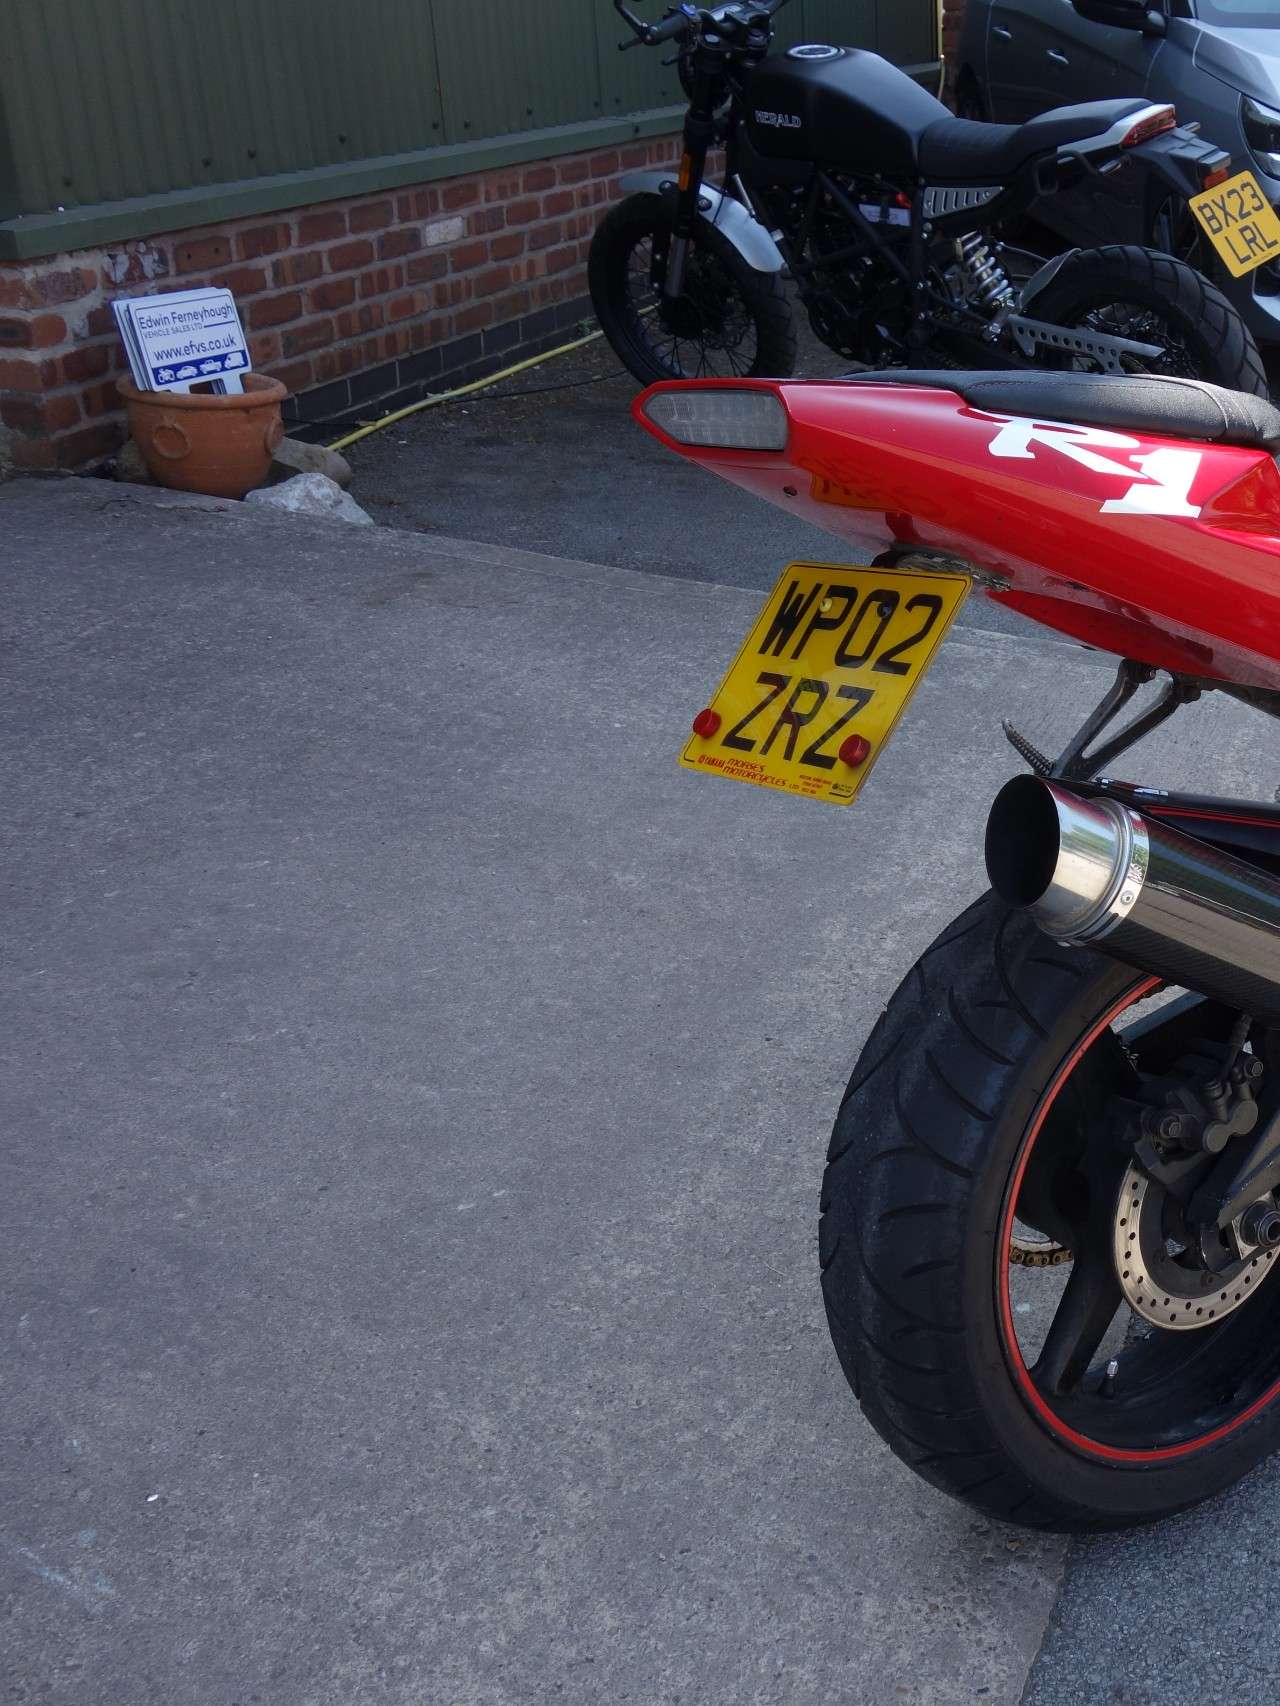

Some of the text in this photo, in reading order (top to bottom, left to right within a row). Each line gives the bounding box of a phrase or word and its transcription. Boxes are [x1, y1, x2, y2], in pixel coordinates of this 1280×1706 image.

[754, 110, 801, 127] HERALD
[1197, 181, 1264, 235] BX23
[1224, 221, 1279, 264] LRL
[139, 303, 233, 330] Edwin Ferneyhough
[143, 327, 170, 339] VEHICLE
[154, 334, 237, 361] www.efvs.co.uk
[968, 407, 1202, 518] R1
[758, 580, 944, 676] WP02
[720, 672, 875, 769] ZRZ
